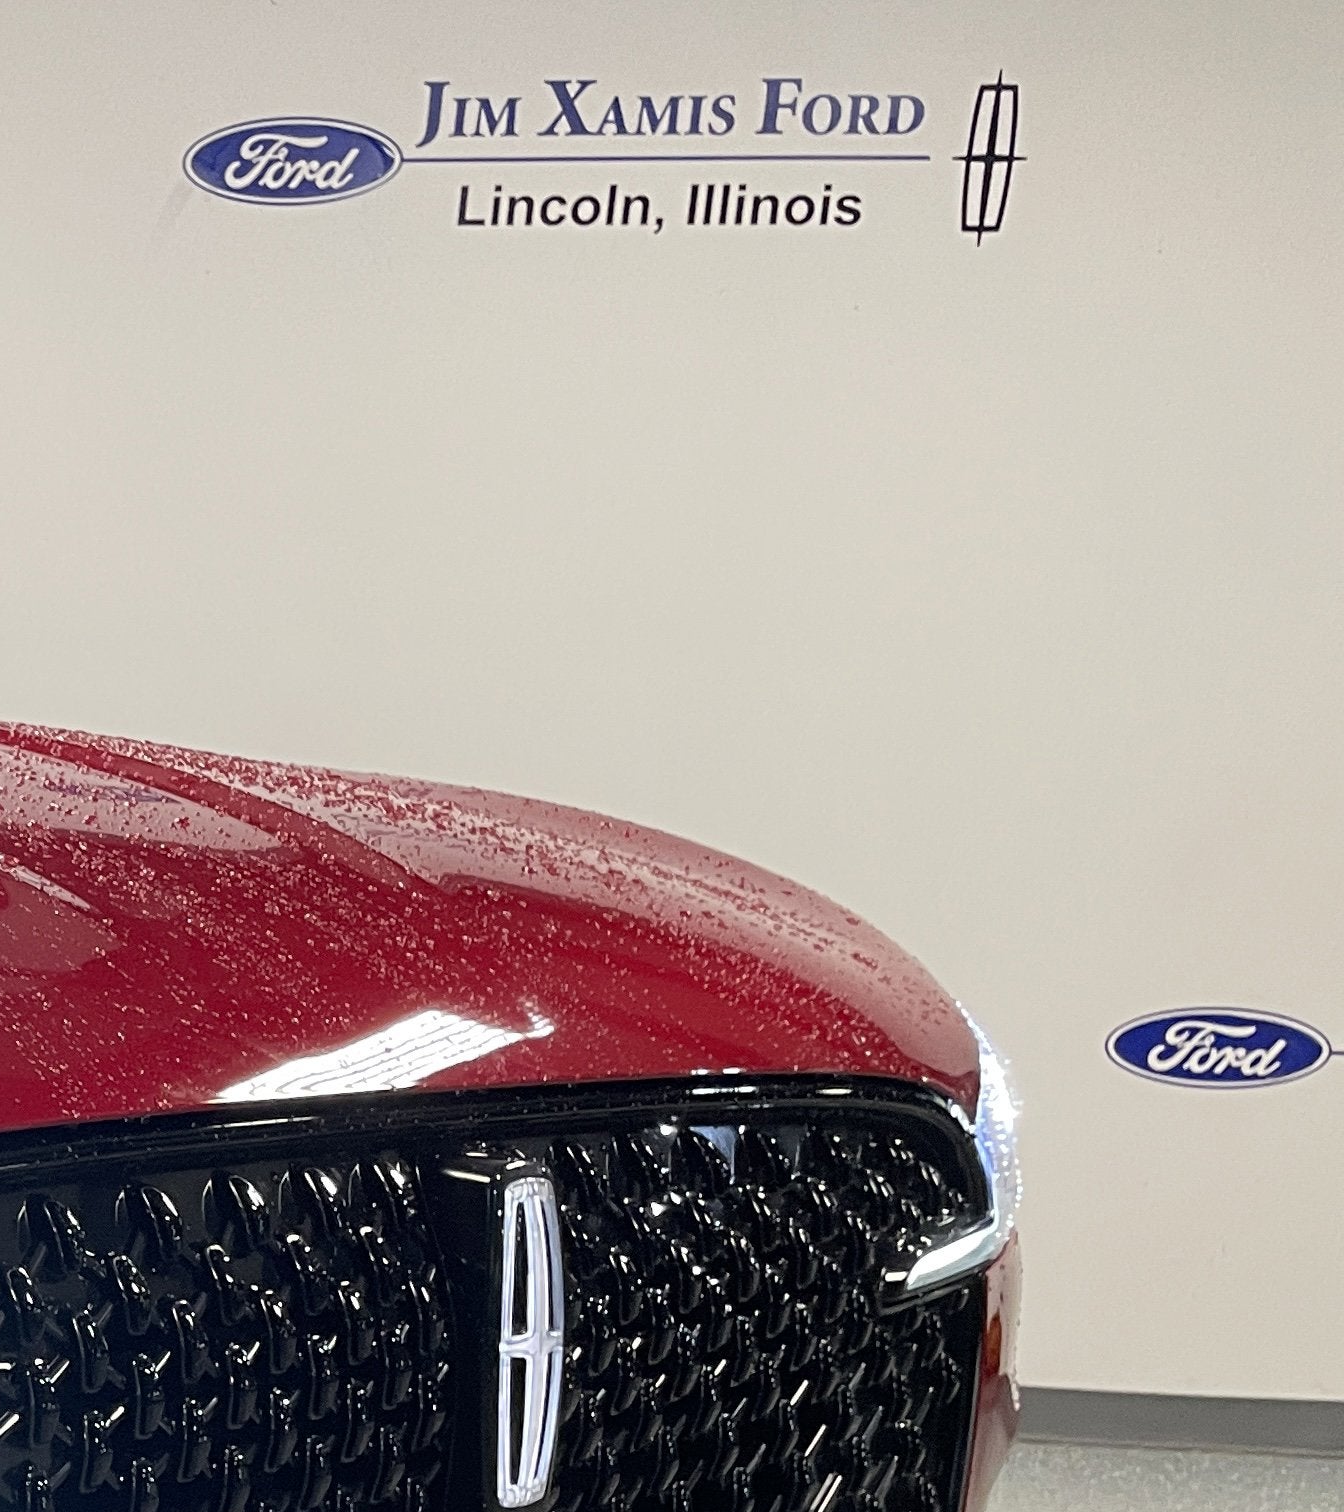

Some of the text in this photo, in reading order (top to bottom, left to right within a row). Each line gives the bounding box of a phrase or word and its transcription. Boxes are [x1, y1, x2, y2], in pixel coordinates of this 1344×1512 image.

[536, 79, 736, 137] XAMIS
[755, 78, 926, 136] FORD
[224, 133, 359, 192] Ford
[457, 183, 863, 235] Lincoln, Illinois
[1147, 1020, 1288, 1077] Ford
